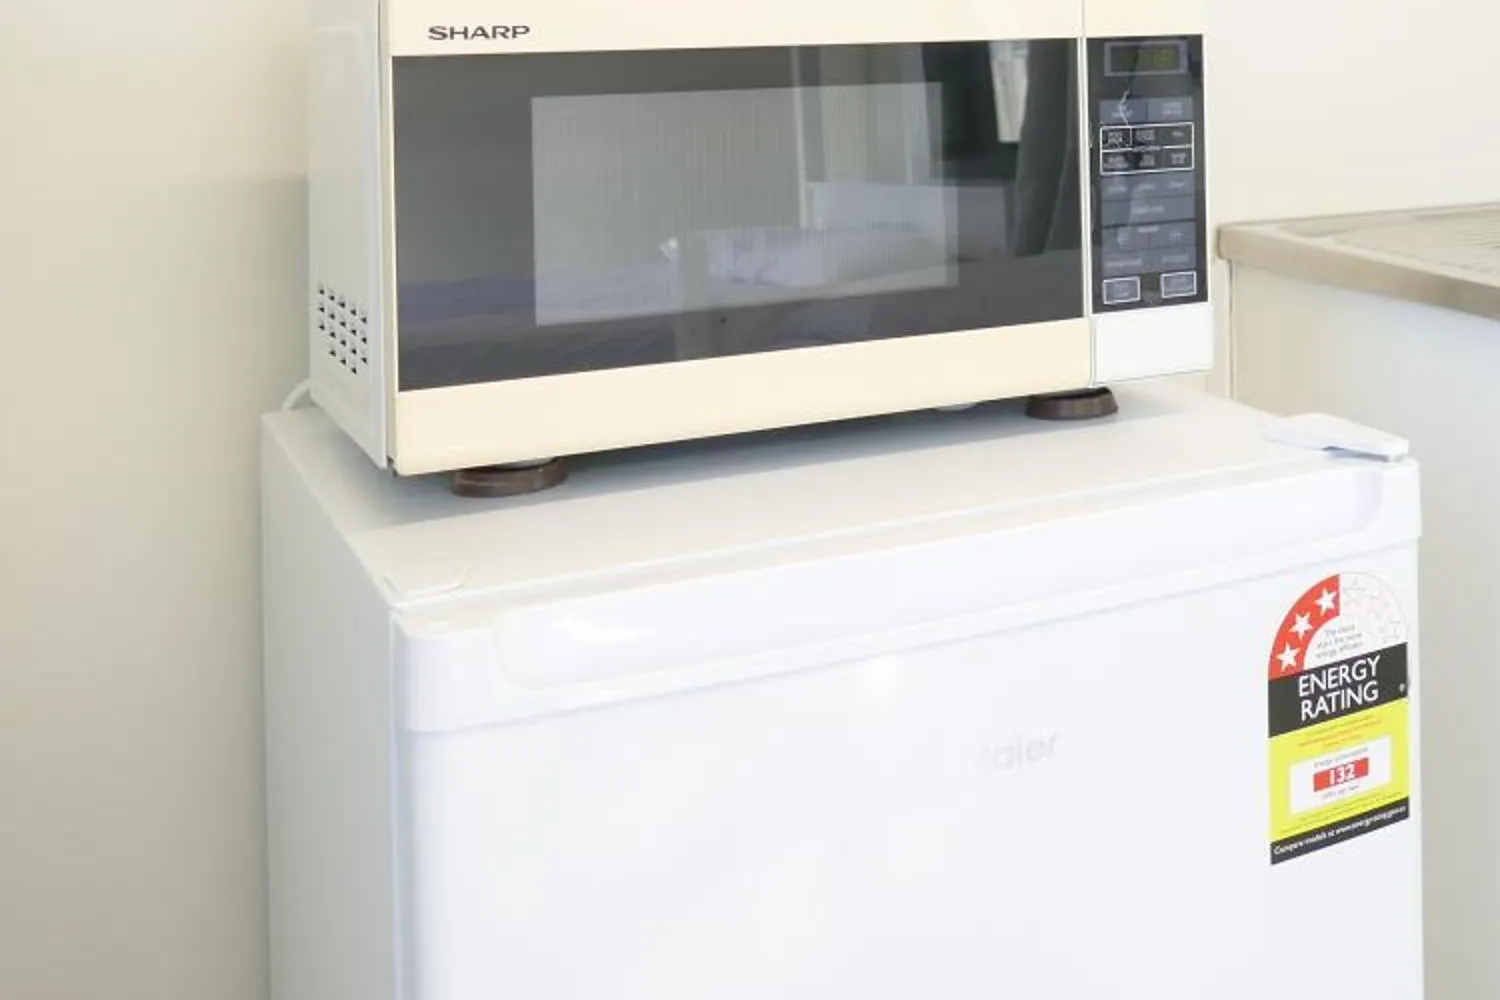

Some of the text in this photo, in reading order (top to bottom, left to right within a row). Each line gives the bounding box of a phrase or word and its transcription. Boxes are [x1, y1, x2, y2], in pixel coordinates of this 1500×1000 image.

[428, 24, 531, 41] SHARP
[1299, 655, 1380, 697] ENERGY
[1301, 680, 1379, 721] RATING
[1328, 763, 1356, 785] 132
